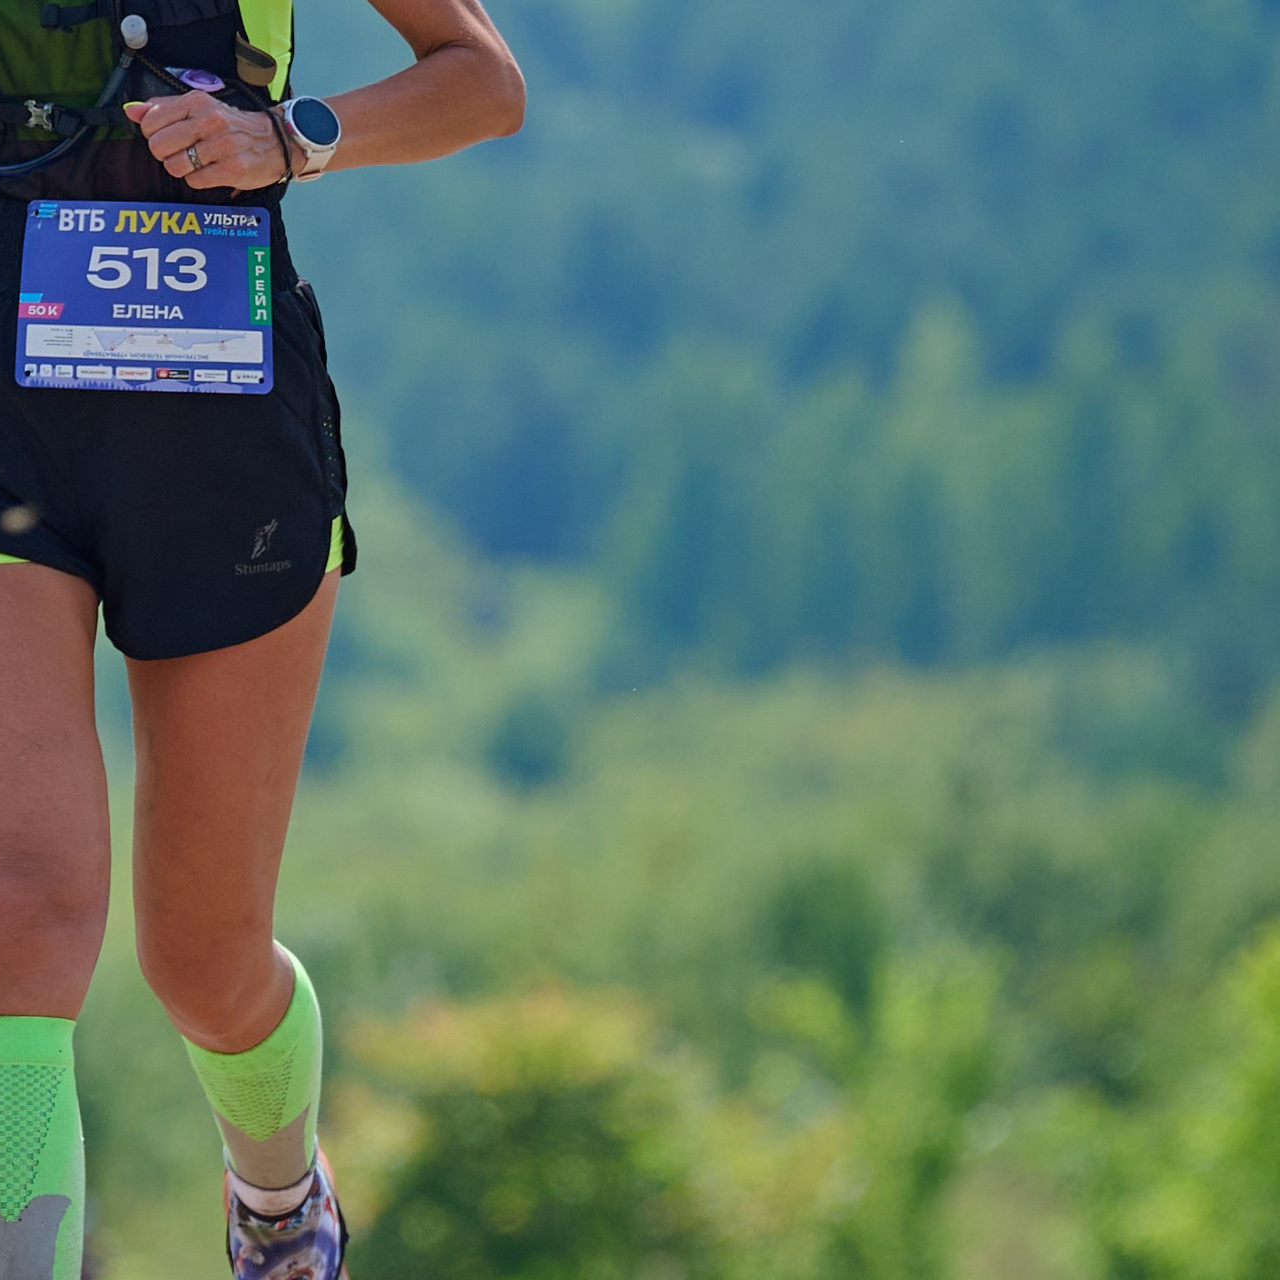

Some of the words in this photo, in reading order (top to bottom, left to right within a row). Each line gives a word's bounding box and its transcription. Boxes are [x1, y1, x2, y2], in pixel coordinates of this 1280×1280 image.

[58, 209, 105, 232] ВТБ
[114, 210, 202, 235] ЛУКА
[203, 213, 258, 227] УЛЬТРА
[203, 228, 228, 237] ТРЕЙЛ
[236, 229, 258, 238] БАЙК
[86, 246, 208, 291] 513
[254, 251, 267, 320] ТРЕЙЛ
[28, 306, 46, 316] 50
[112, 304, 184, 320] ЕЛЕНА
[234, 559, 292, 576] Stuntaps
